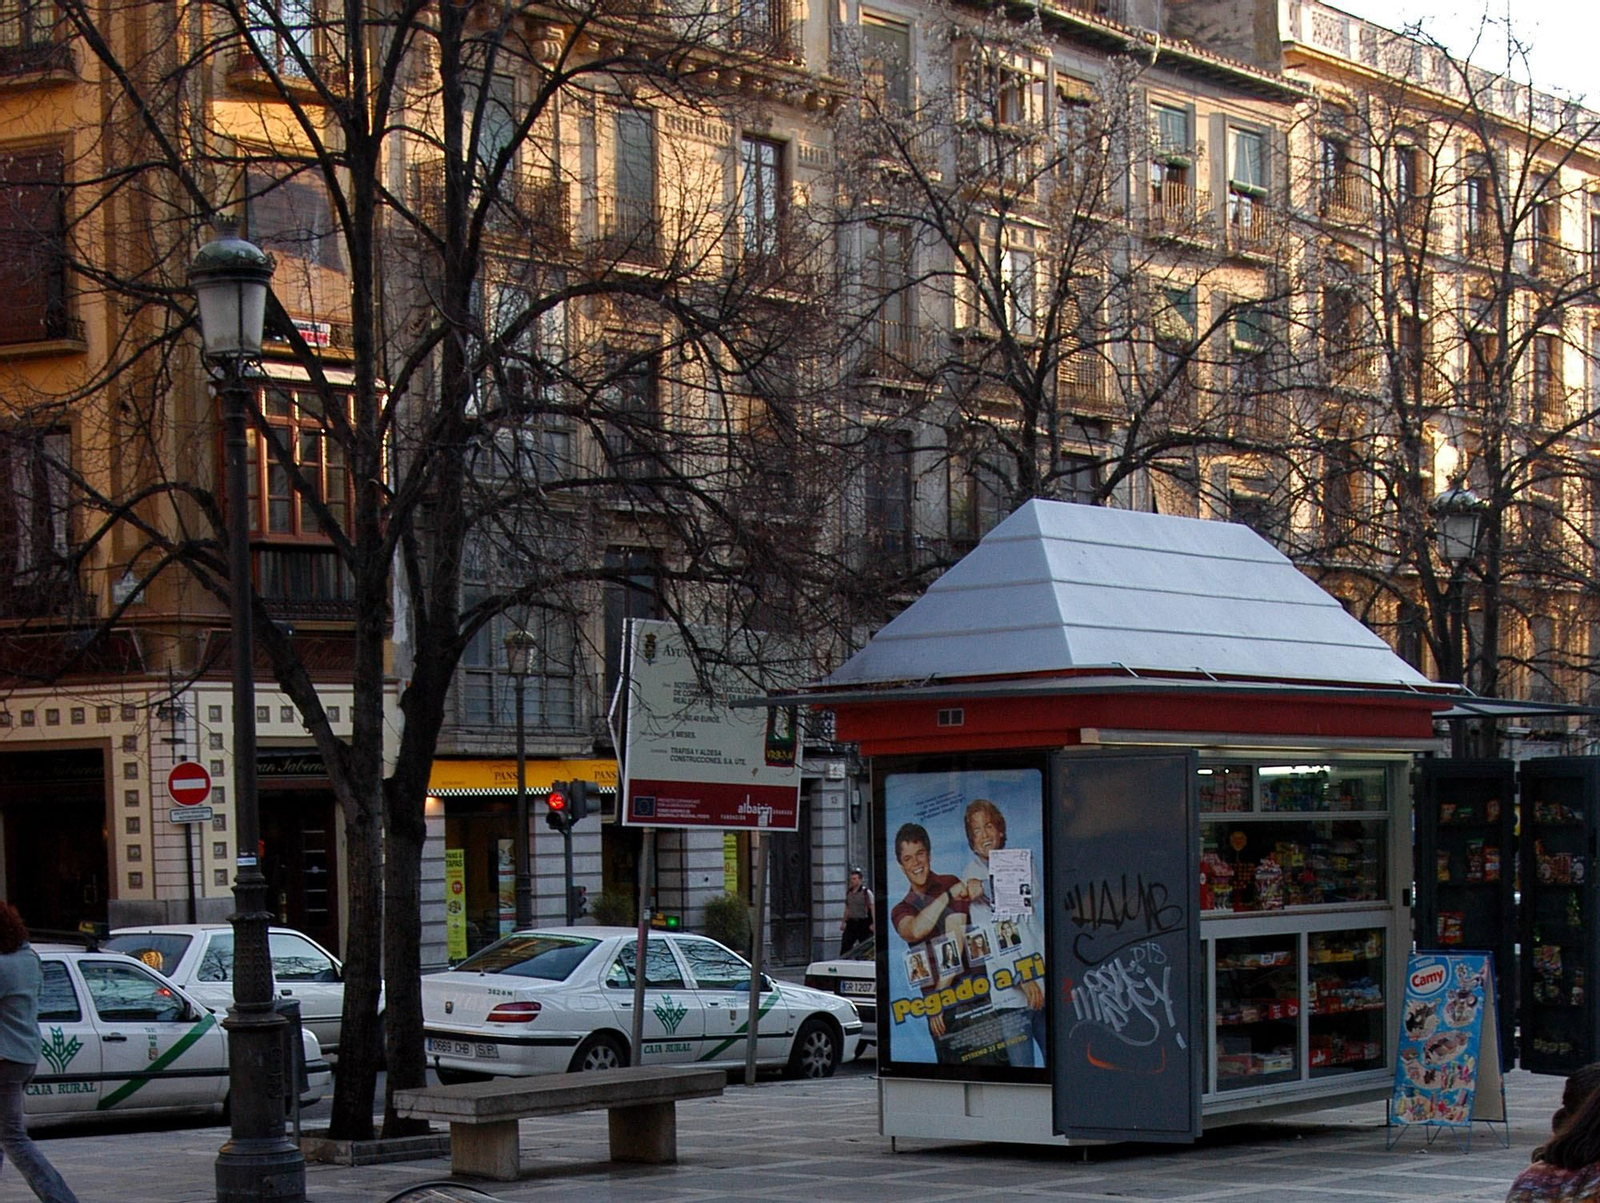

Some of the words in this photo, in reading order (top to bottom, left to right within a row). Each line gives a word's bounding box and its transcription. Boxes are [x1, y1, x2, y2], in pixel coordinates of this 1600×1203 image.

[1411, 969, 1444, 988] Camy
[855, 983, 873, 993] 1207
[892, 976, 990, 1024] Pegado
[994, 968, 1012, 991] a
[1014, 953, 1045, 982] Ti
[665, 1042, 692, 1053] RURAL
[25, 1082, 53, 1096] CAJA
[58, 1081, 98, 1095] RURAL
